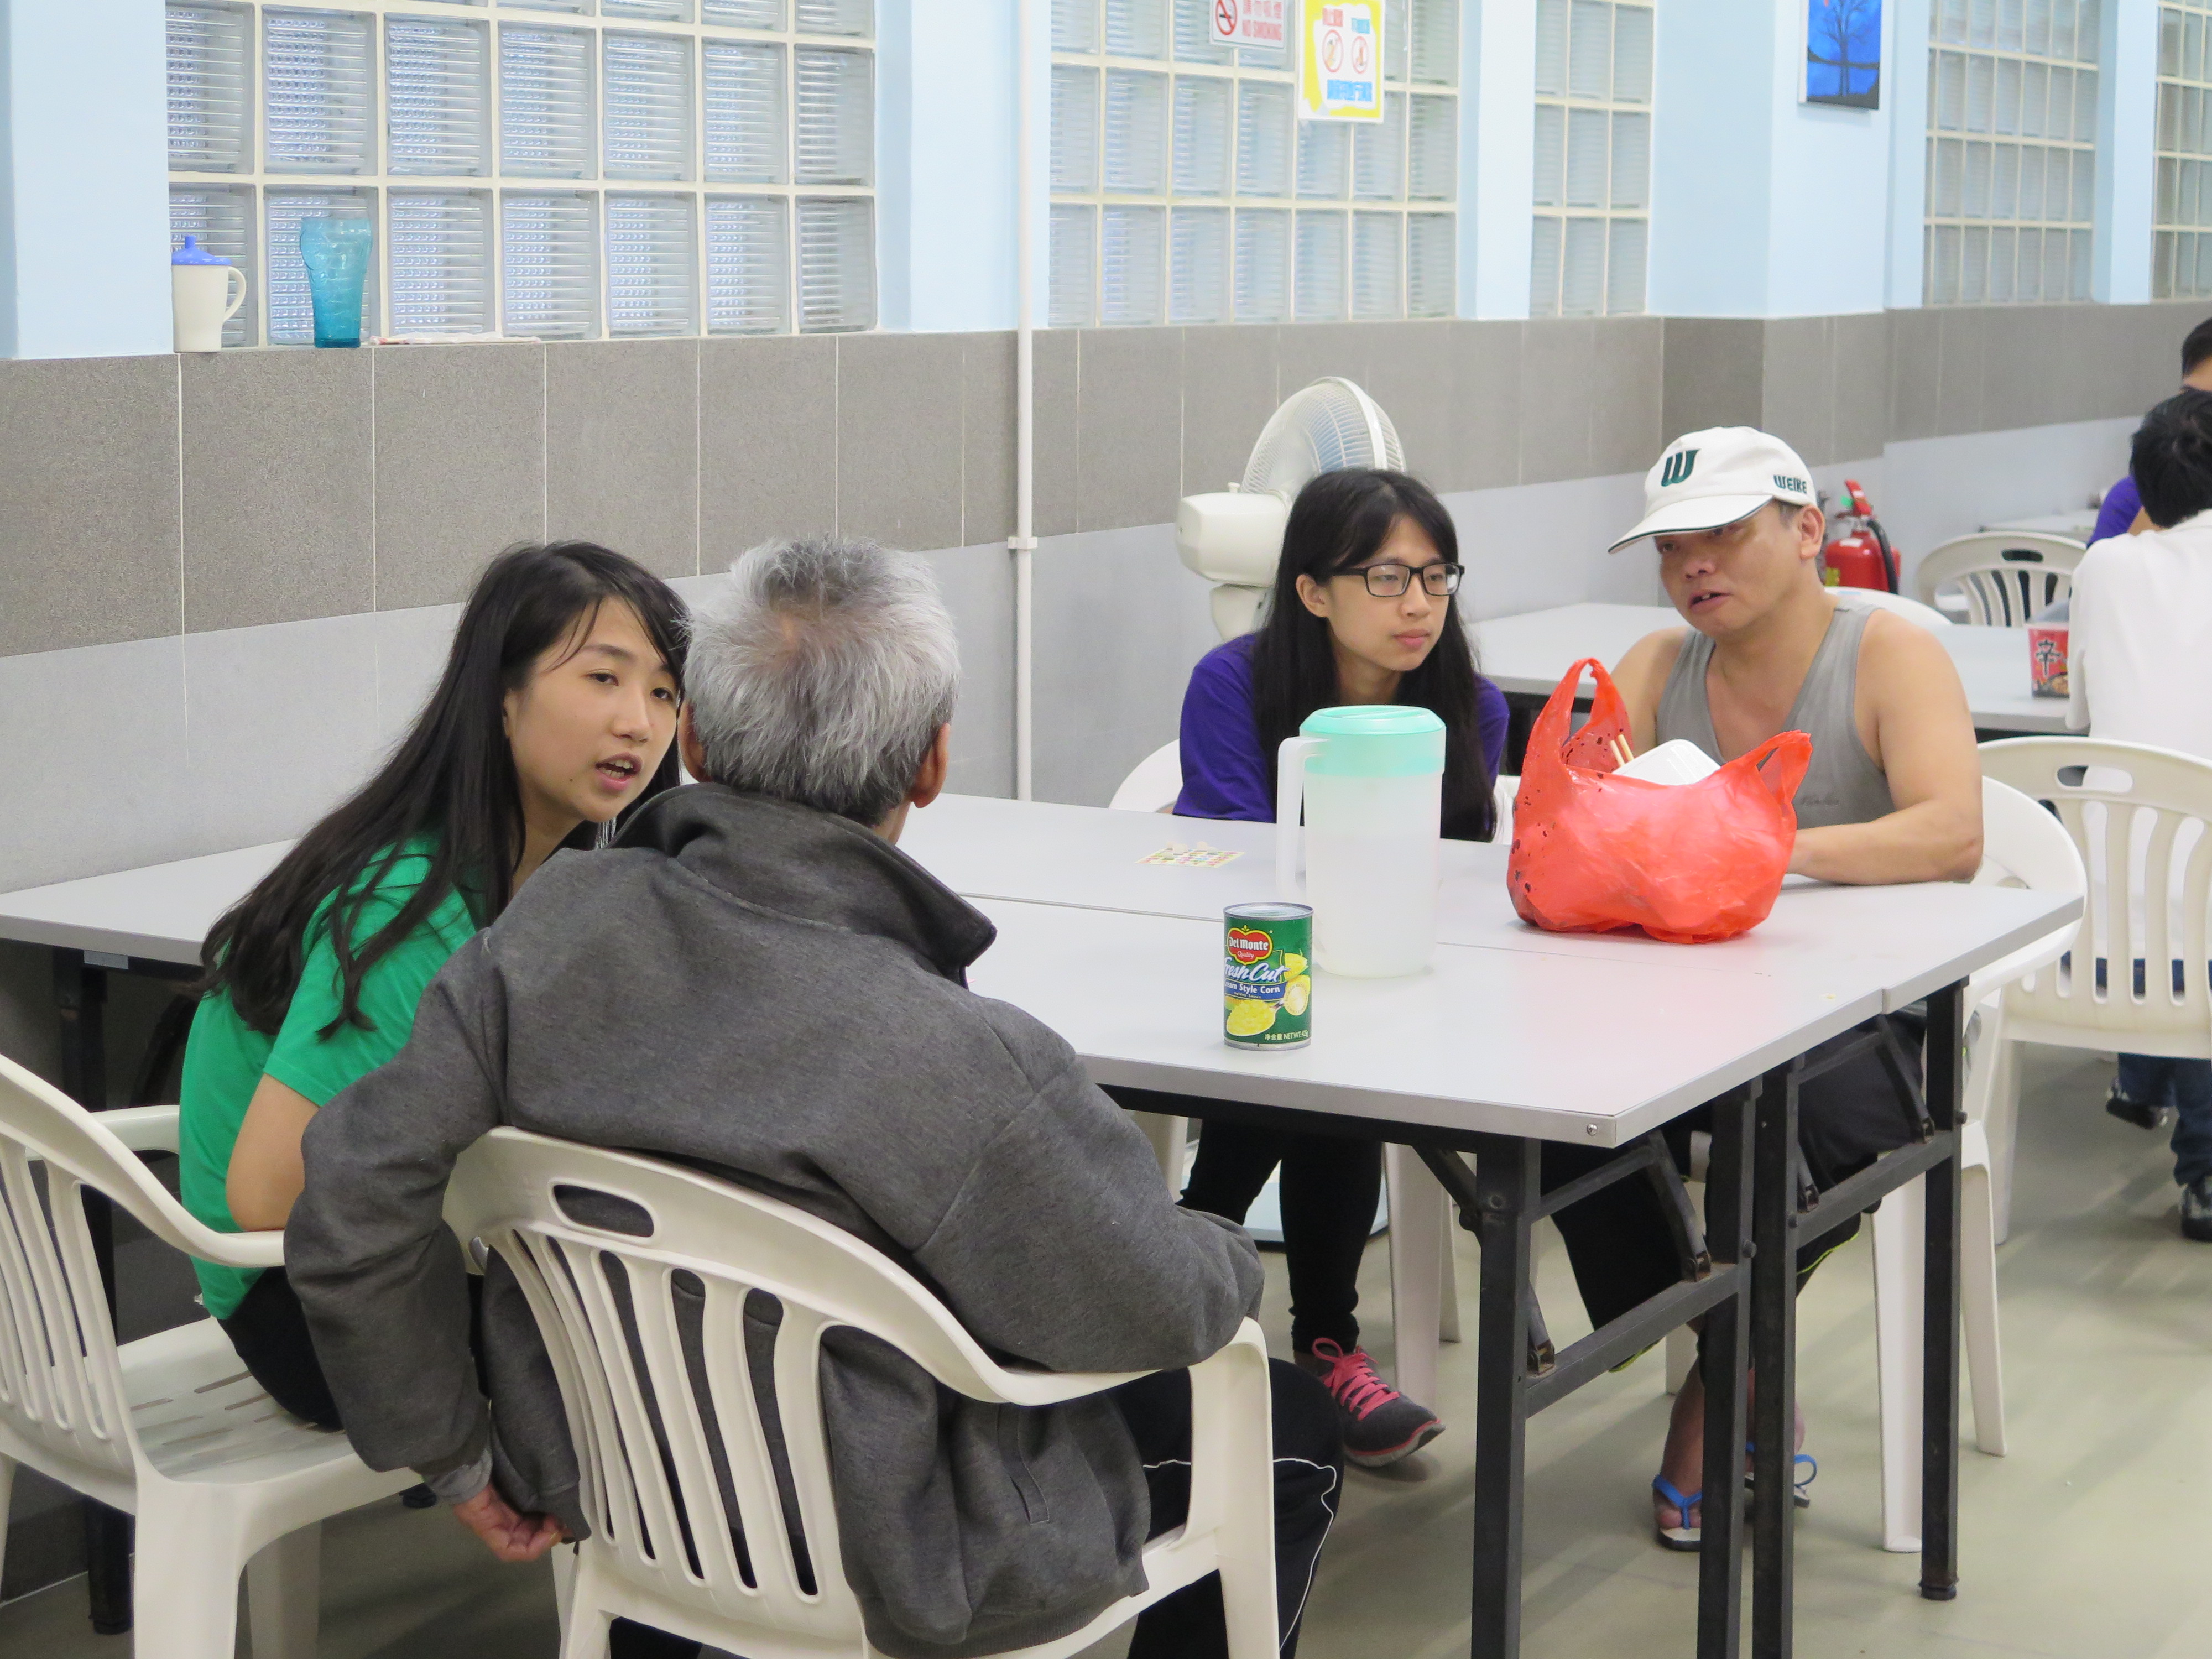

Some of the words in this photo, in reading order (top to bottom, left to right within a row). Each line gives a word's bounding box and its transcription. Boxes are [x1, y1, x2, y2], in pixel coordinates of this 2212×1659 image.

[1229, 936, 1239, 948] Del
[1240, 939, 1269, 951] Monte
[1237, 950, 1254, 959] Quality
[1249, 962, 1291, 982] Cut
[1239, 983, 1258, 994] Style
[1260, 985, 1280, 994] Corn
